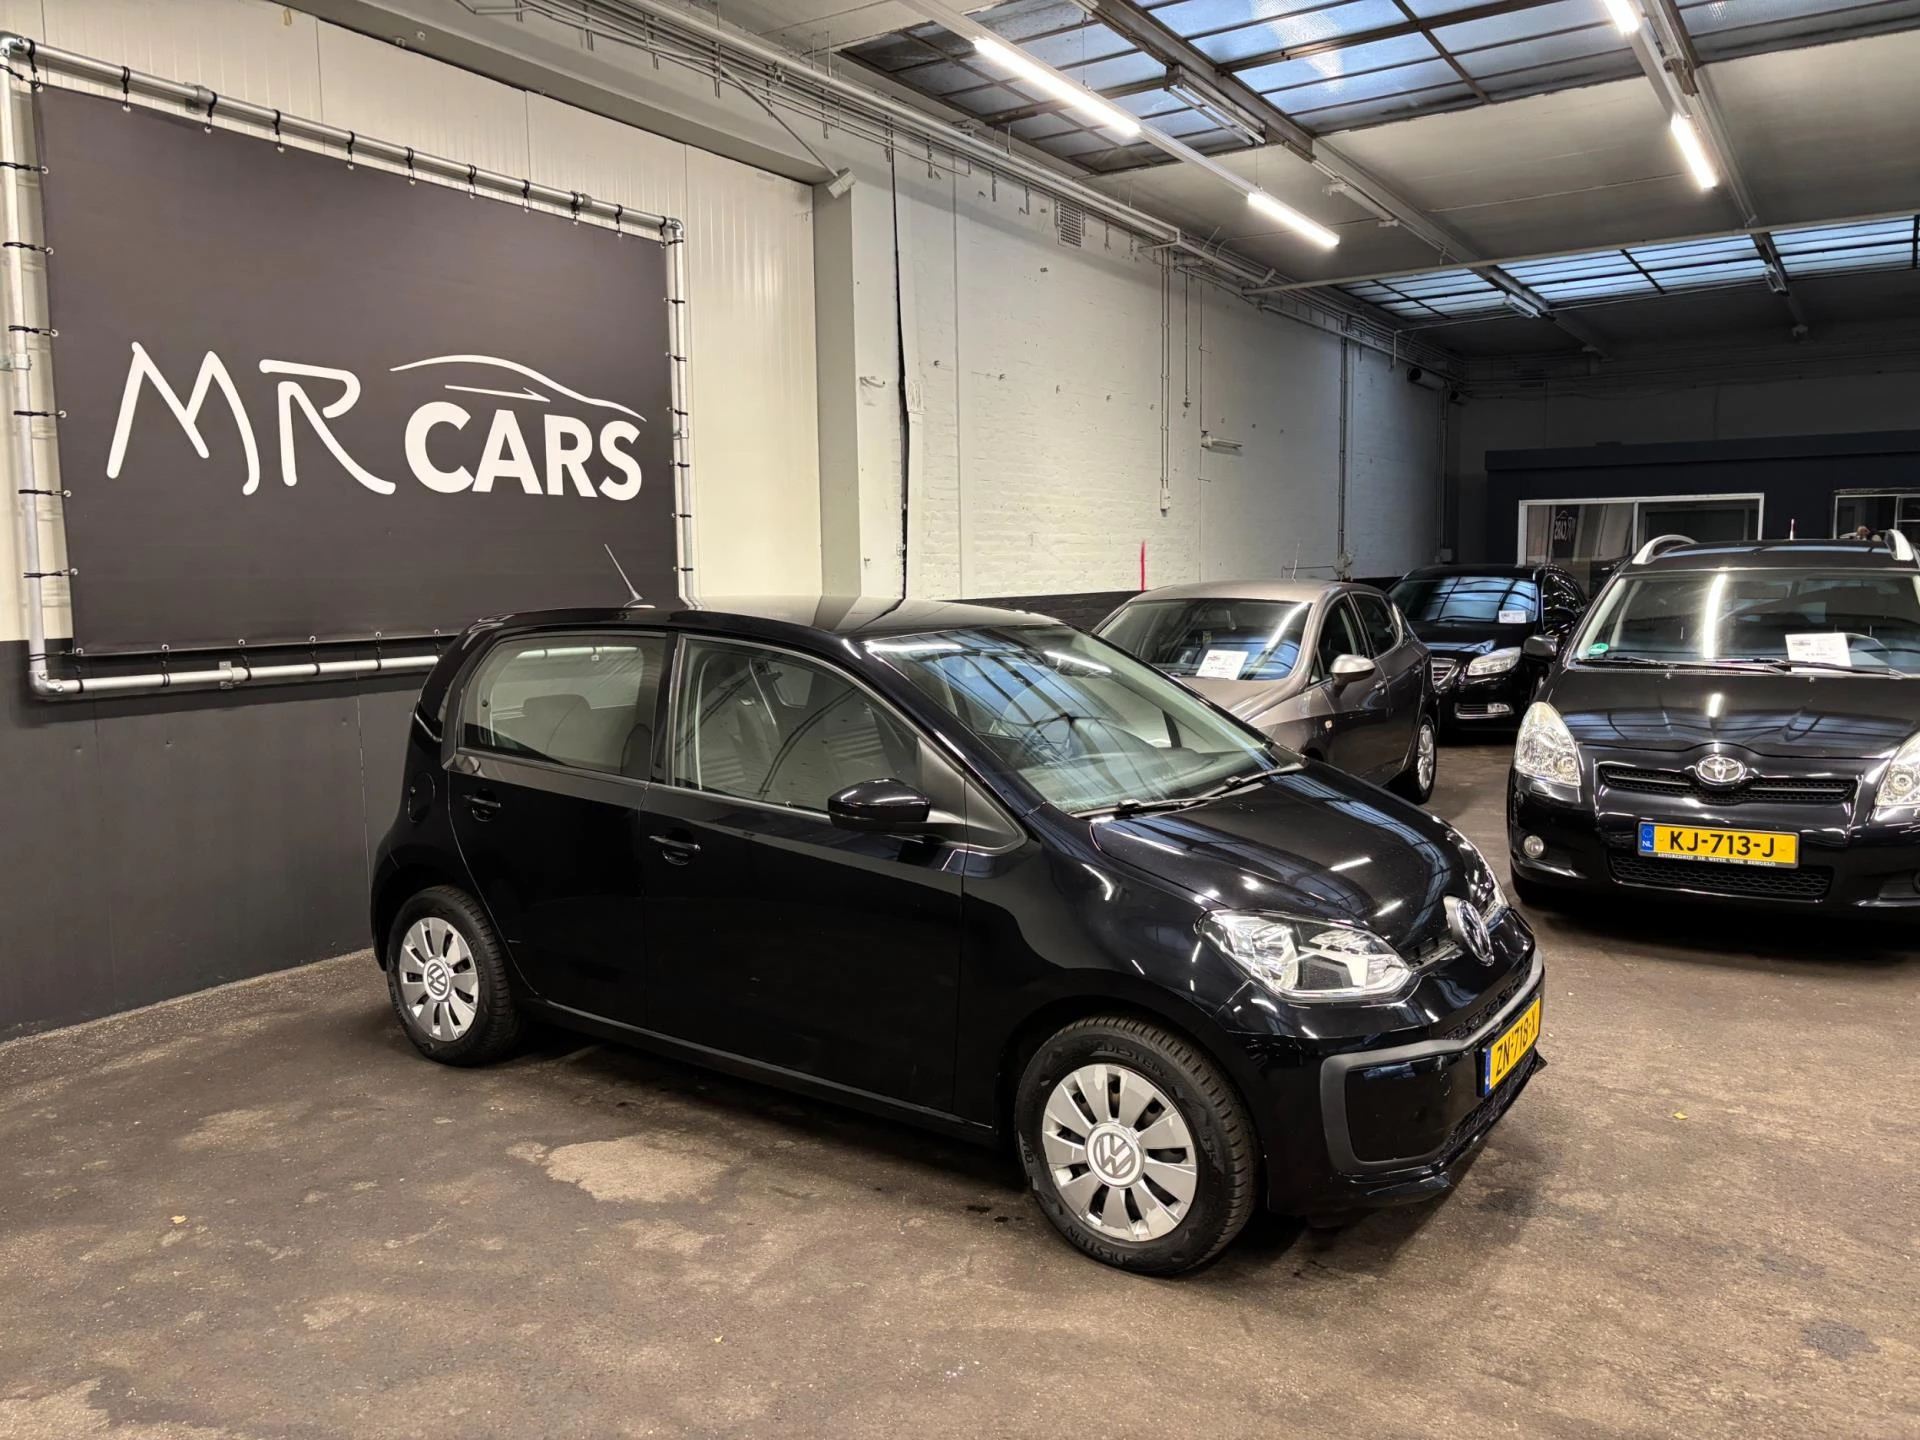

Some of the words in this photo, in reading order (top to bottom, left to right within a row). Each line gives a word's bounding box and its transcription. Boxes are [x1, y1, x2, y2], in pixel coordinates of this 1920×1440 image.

[106, 341, 396, 496] MR
[404, 401, 642, 501] CARS
[1642, 840, 1653, 848] NL
[1669, 830, 1775, 858] KJ-713-J
